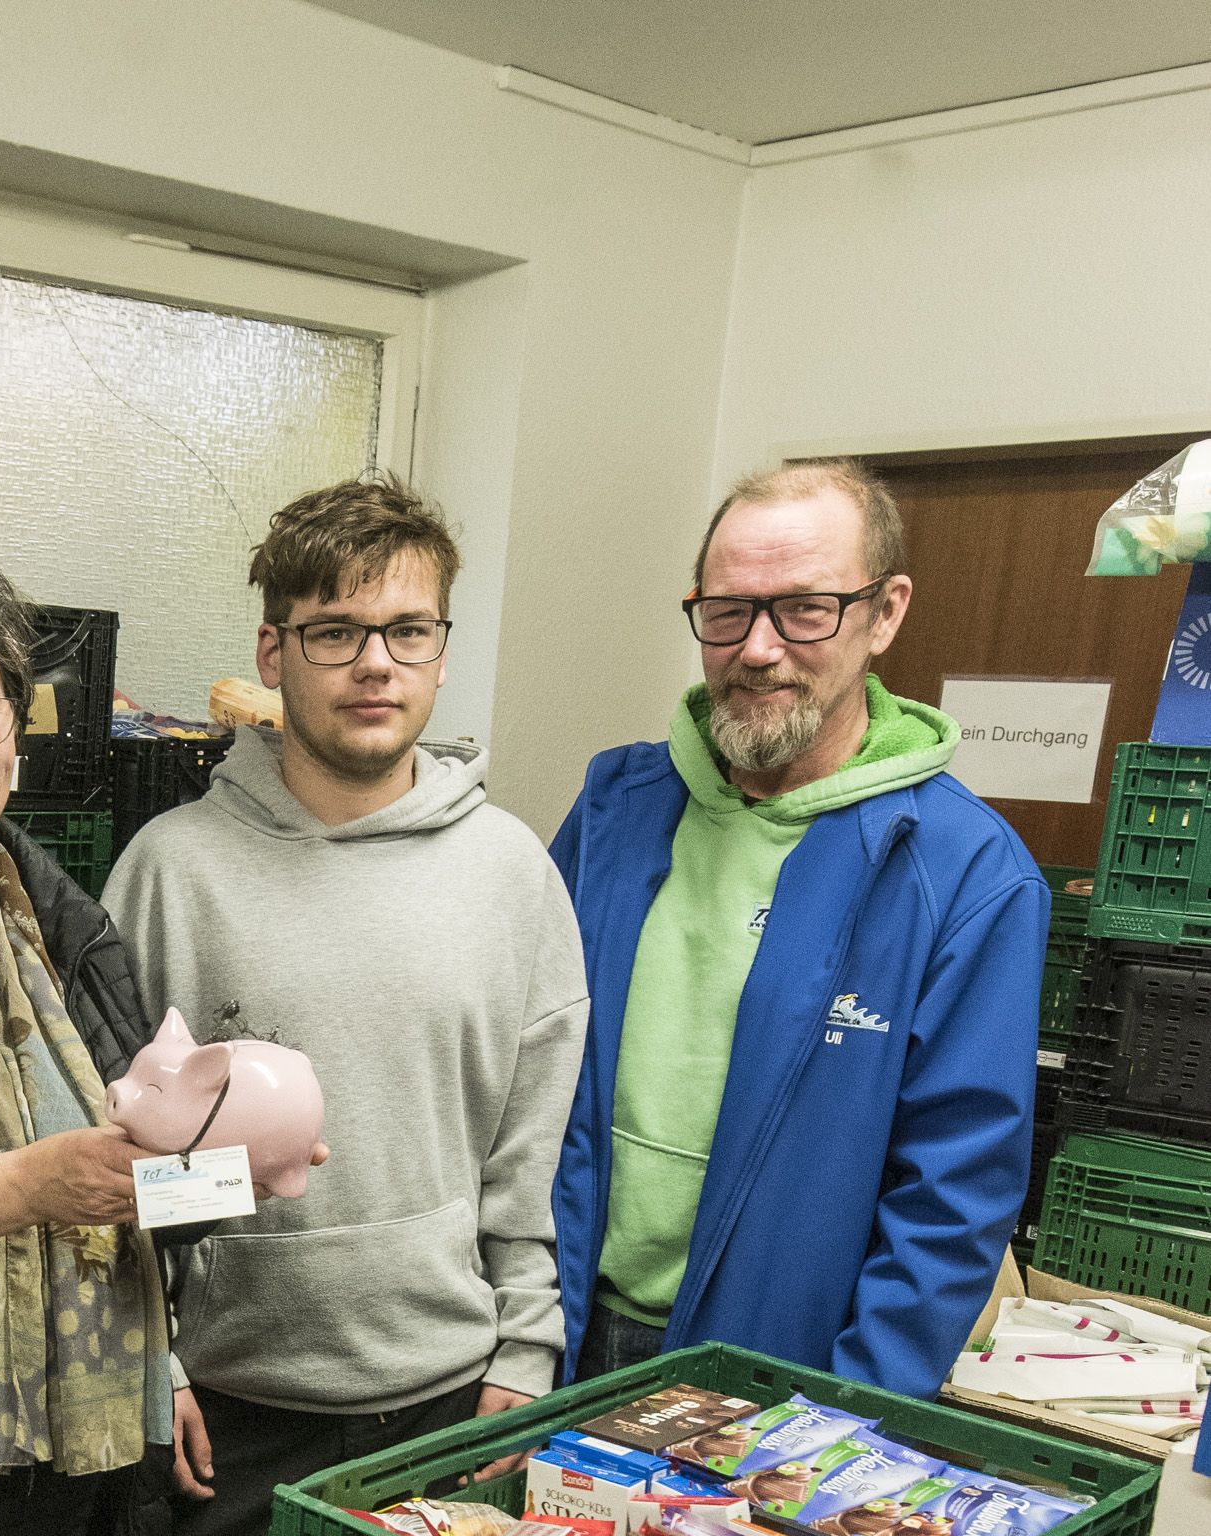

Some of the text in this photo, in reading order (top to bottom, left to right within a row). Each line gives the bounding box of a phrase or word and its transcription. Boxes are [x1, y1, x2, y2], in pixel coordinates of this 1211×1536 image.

[958, 725, 1089, 749] ein Durchgang
[825, 1030, 843, 1045] Uli
[223, 1178, 243, 1187] PADI
[639, 1400, 701, 1426] share
[756, 1407, 833, 1451] Haselnuss
[562, 1472, 594, 1488] Sondey
[817, 1447, 897, 1495] Haselnuss
[545, 1488, 612, 1517] SCHOKO-KEKS
